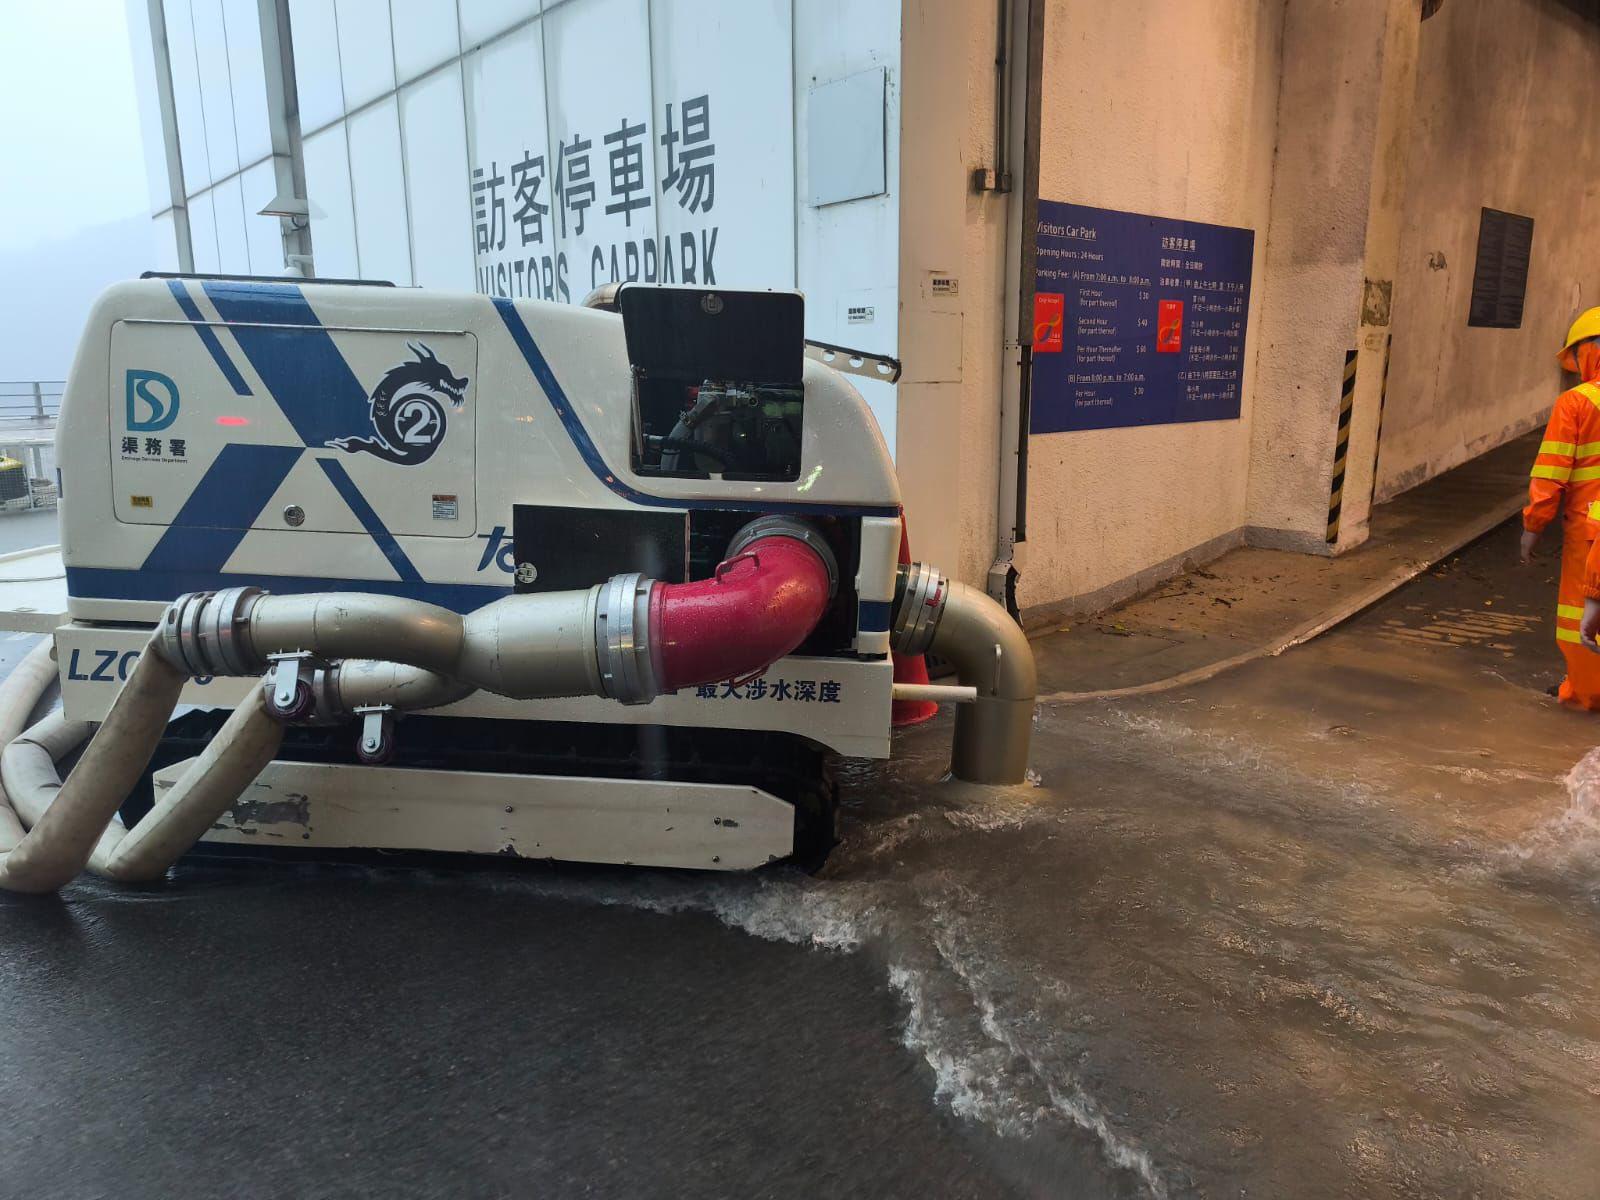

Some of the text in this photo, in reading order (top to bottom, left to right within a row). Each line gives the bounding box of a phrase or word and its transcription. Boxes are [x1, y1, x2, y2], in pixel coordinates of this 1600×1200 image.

[473, 94, 716, 254] 訪客停車場
[1066, 225, 1079, 238] Car
[1080, 226, 1097, 240] Park
[479, 252, 571, 304] VISITORS
[404, 402, 431, 443] 2
[121, 436, 186, 457] 渠務署
[695, 678, 841, 703] 最大涉水深度
